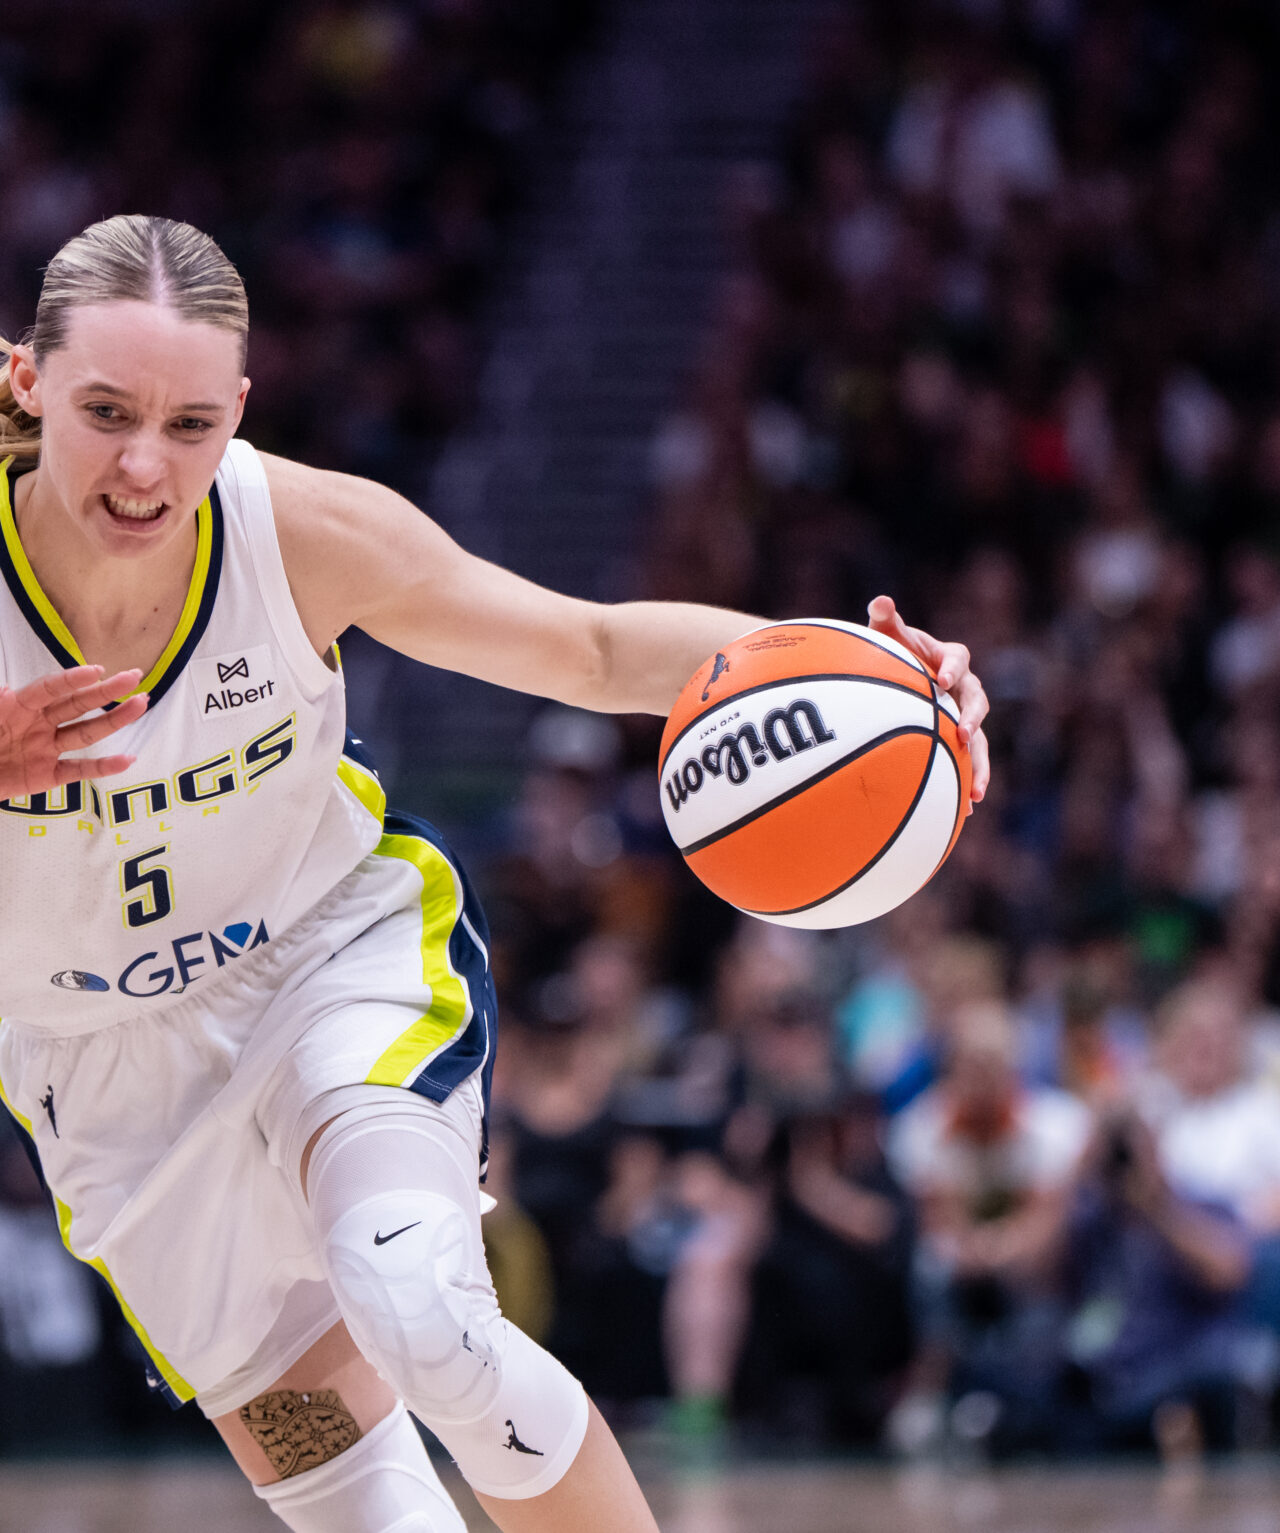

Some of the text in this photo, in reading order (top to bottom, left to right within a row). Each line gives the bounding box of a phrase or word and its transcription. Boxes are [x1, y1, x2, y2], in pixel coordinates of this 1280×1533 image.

[204, 680, 275, 714] Albert
[699, 712, 740, 740] EVO NXT
[665, 698, 837, 813] Wilson
[119, 841, 176, 930] 5
